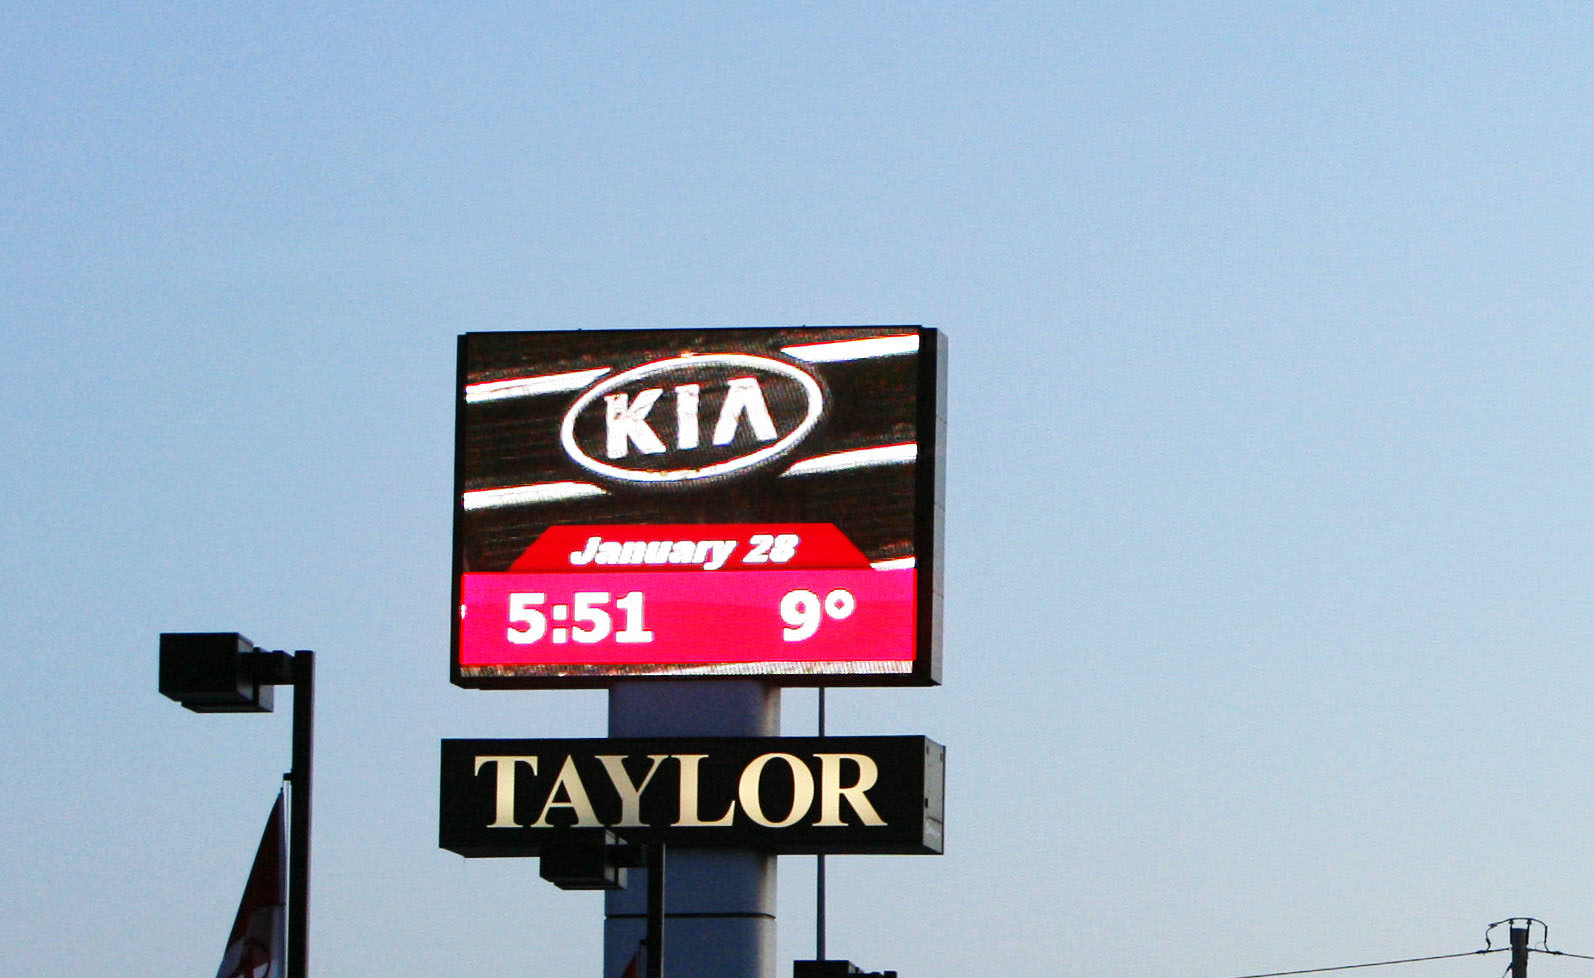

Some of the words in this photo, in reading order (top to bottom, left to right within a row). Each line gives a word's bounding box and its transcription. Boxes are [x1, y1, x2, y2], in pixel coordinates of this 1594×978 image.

[604, 376, 779, 460] KIA
[569, 535, 737, 571] January
[742, 532, 799, 565] 28
[507, 590, 655, 646] 5:51
[779, 588, 857, 643] 9°
[473, 751, 889, 830] TAYLOR
